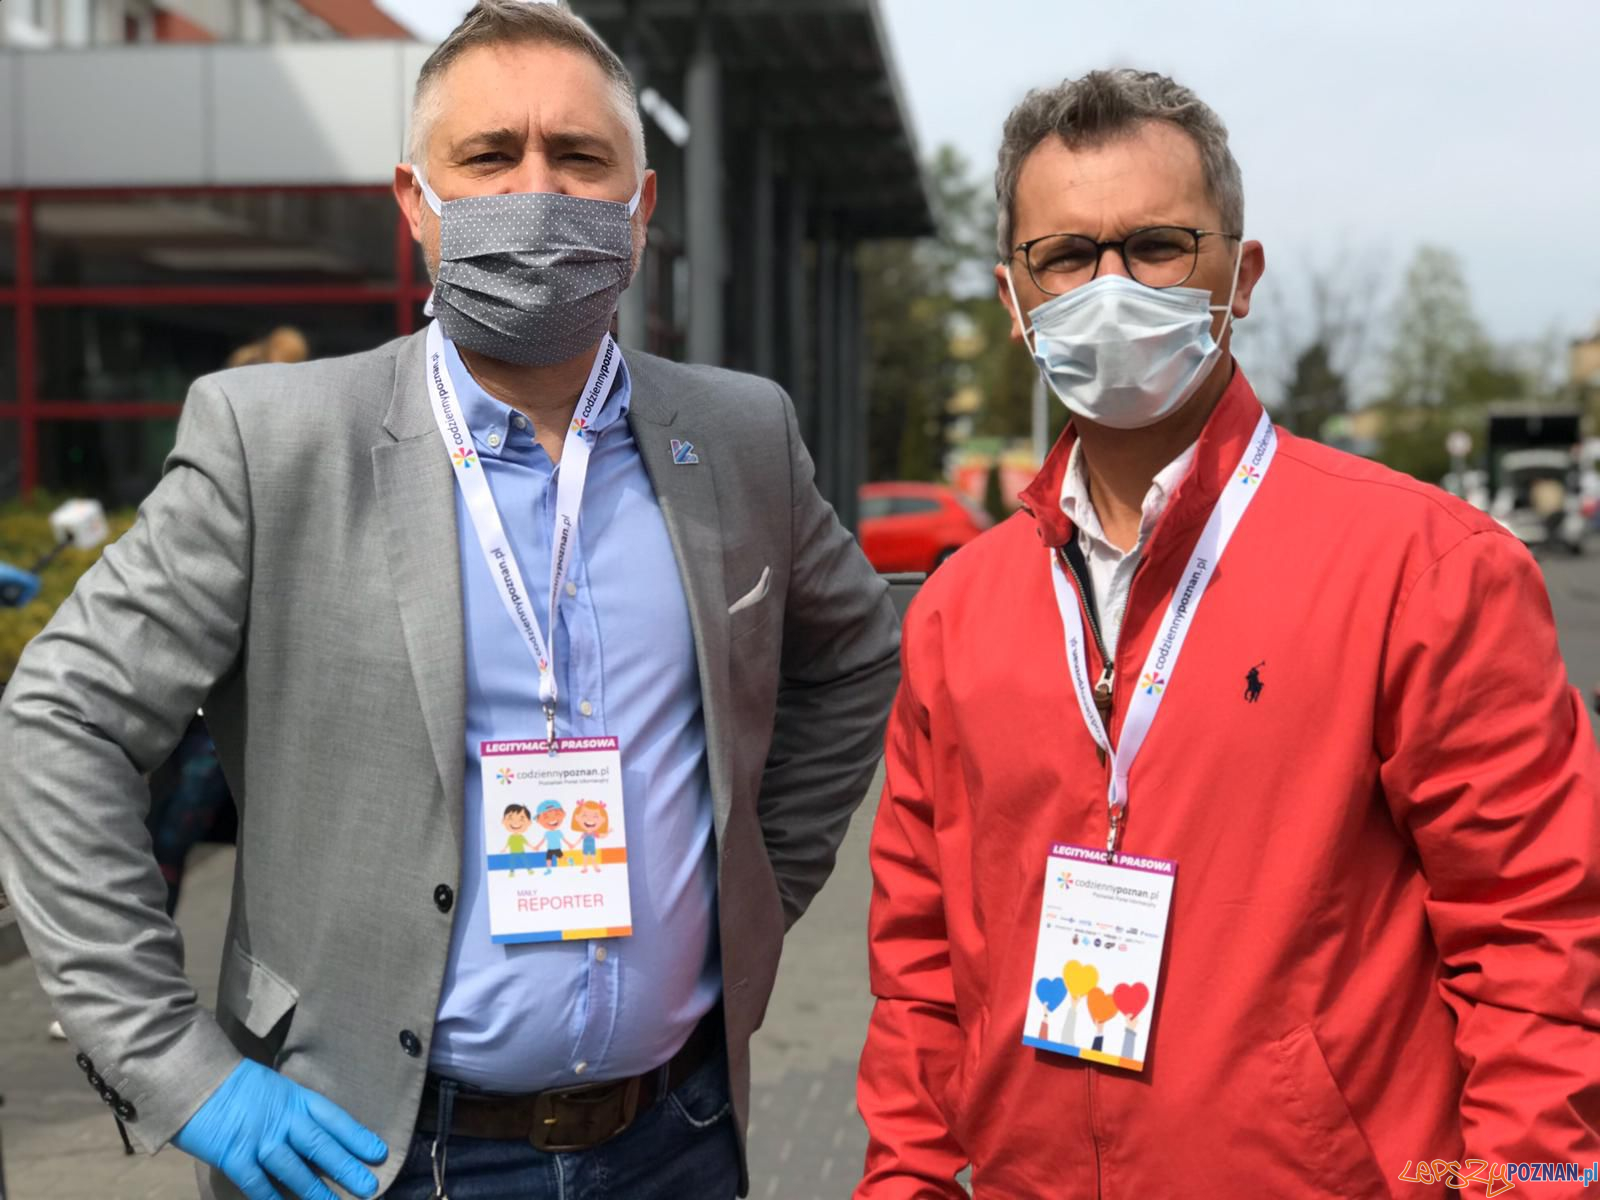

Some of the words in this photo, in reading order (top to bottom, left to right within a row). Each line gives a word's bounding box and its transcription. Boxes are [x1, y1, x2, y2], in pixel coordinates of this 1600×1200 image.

[431, 352, 462, 445] codziennypoznan.pl
[490, 548, 541, 657] codziennypoznan.pl
[1155, 558, 1207, 670] codziennypoznan.pl
[486, 741, 558, 753] LEGITYMACA
[561, 738, 616, 750] PRASOWA
[516, 765, 610, 780] codziennypoznan.pl
[1052, 844, 1118, 864] LEGITYMACA
[1119, 855, 1172, 872] PRASOWA
[517, 893, 605, 912] REPORTER
